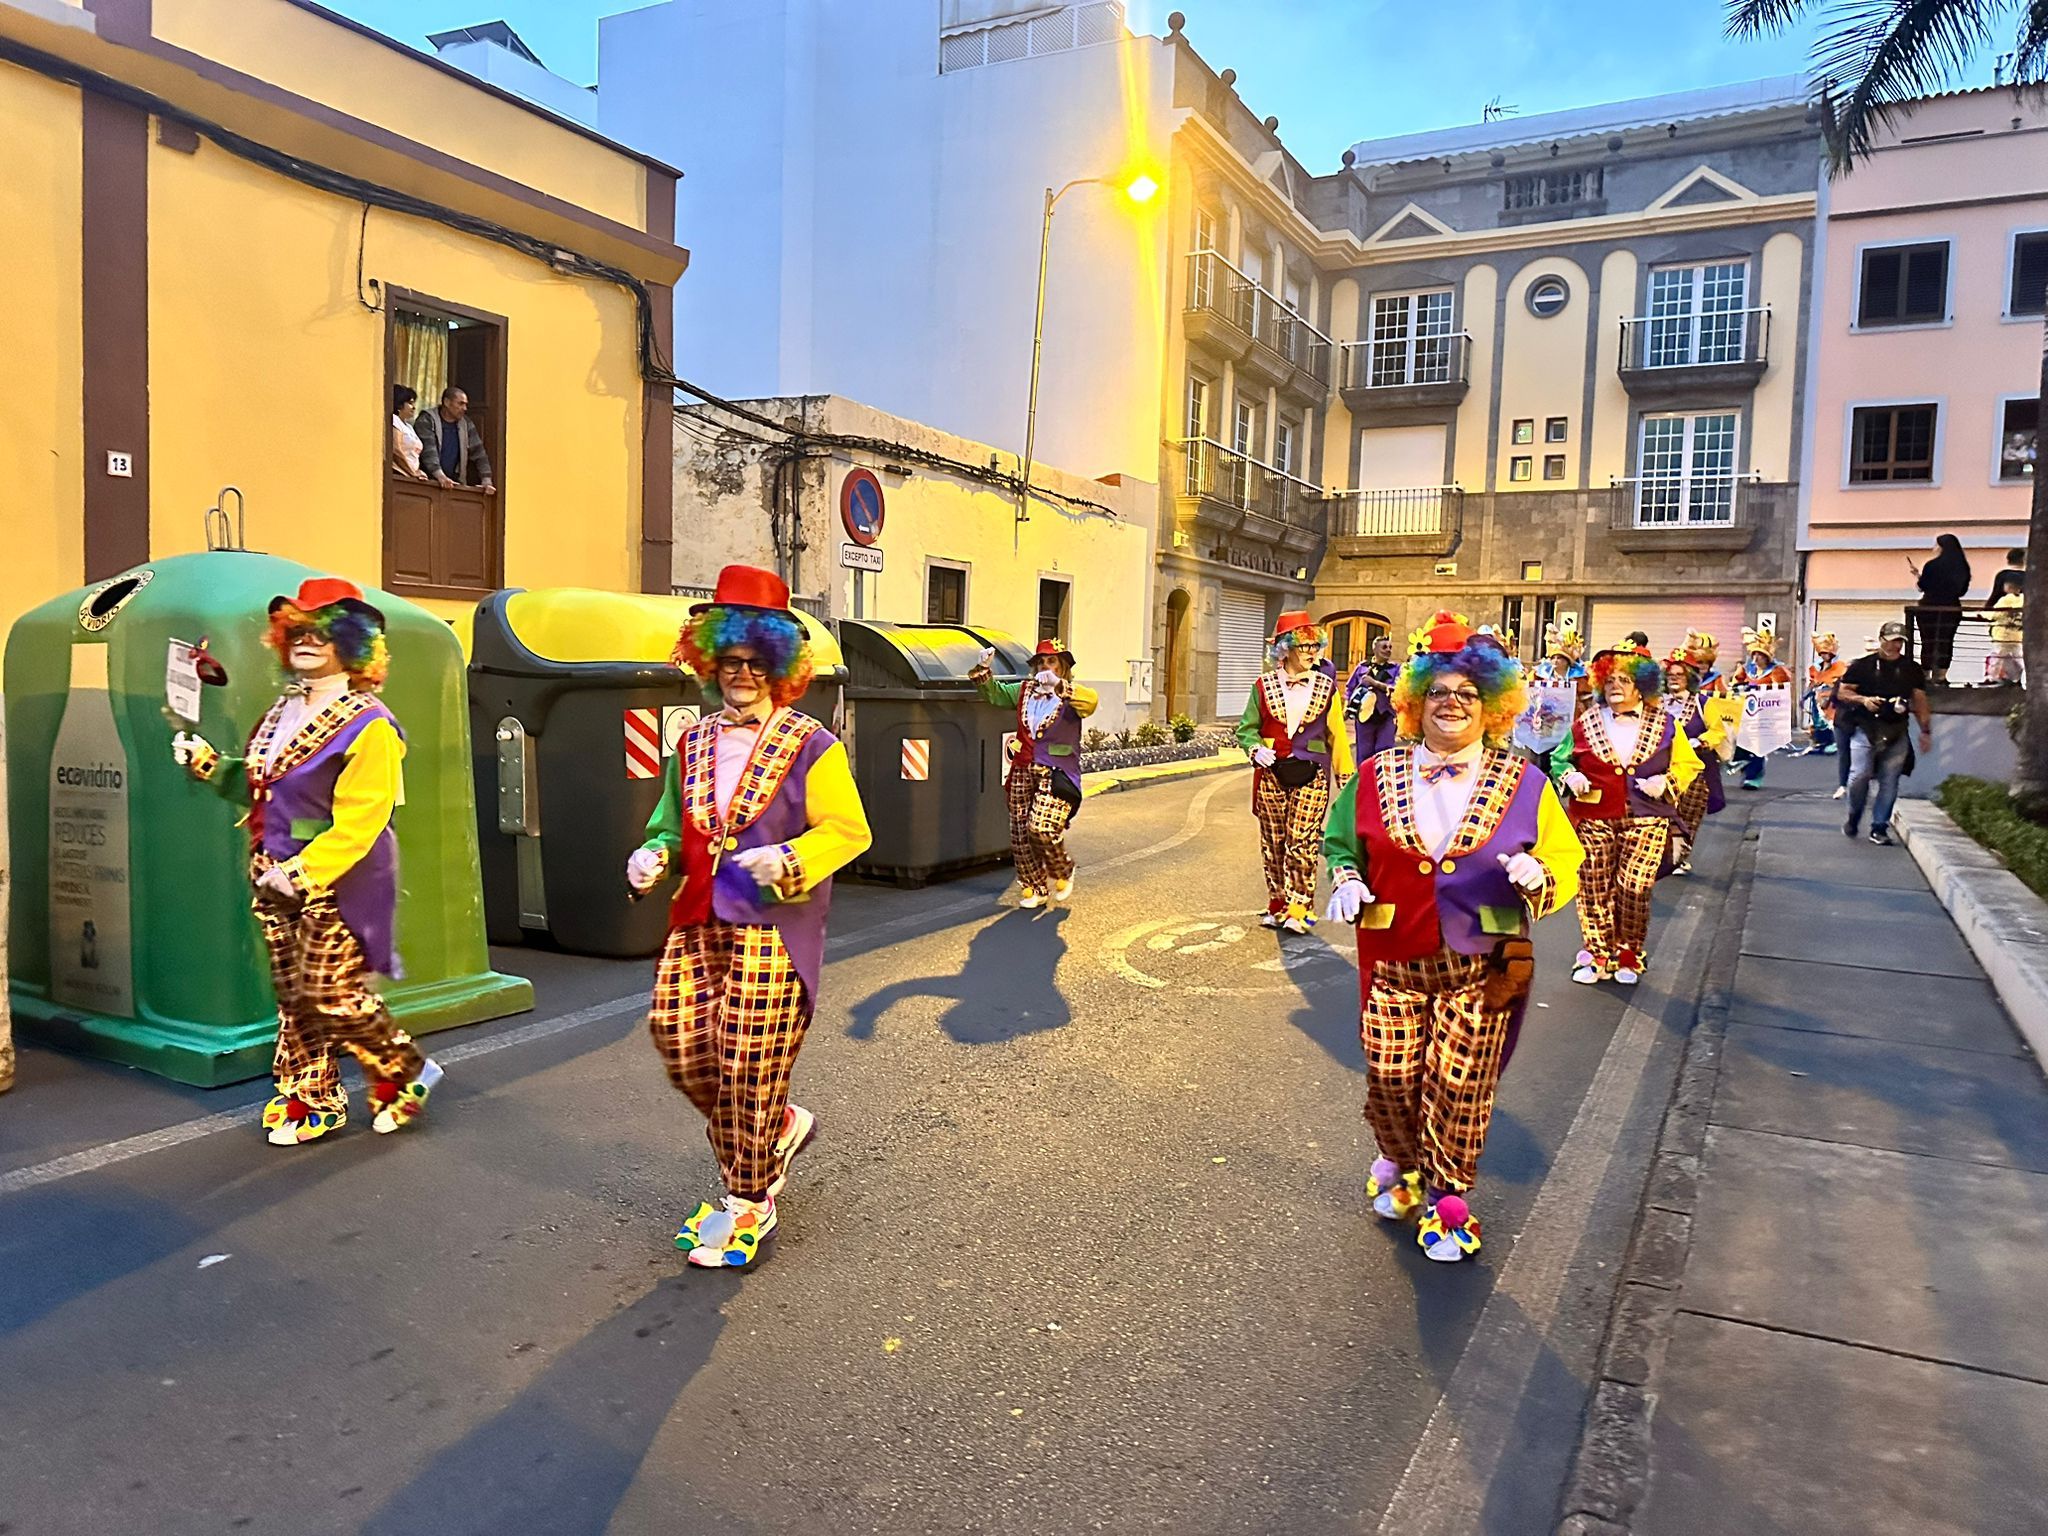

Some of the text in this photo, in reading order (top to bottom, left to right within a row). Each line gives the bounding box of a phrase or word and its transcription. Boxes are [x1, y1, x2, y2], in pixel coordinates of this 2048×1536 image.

[112, 457, 128, 472] 13
[844, 550, 881, 565] EXCEPTO TAXI
[86, 605, 120, 629] VIDRIO
[56, 761, 123, 789] ecovidrio
